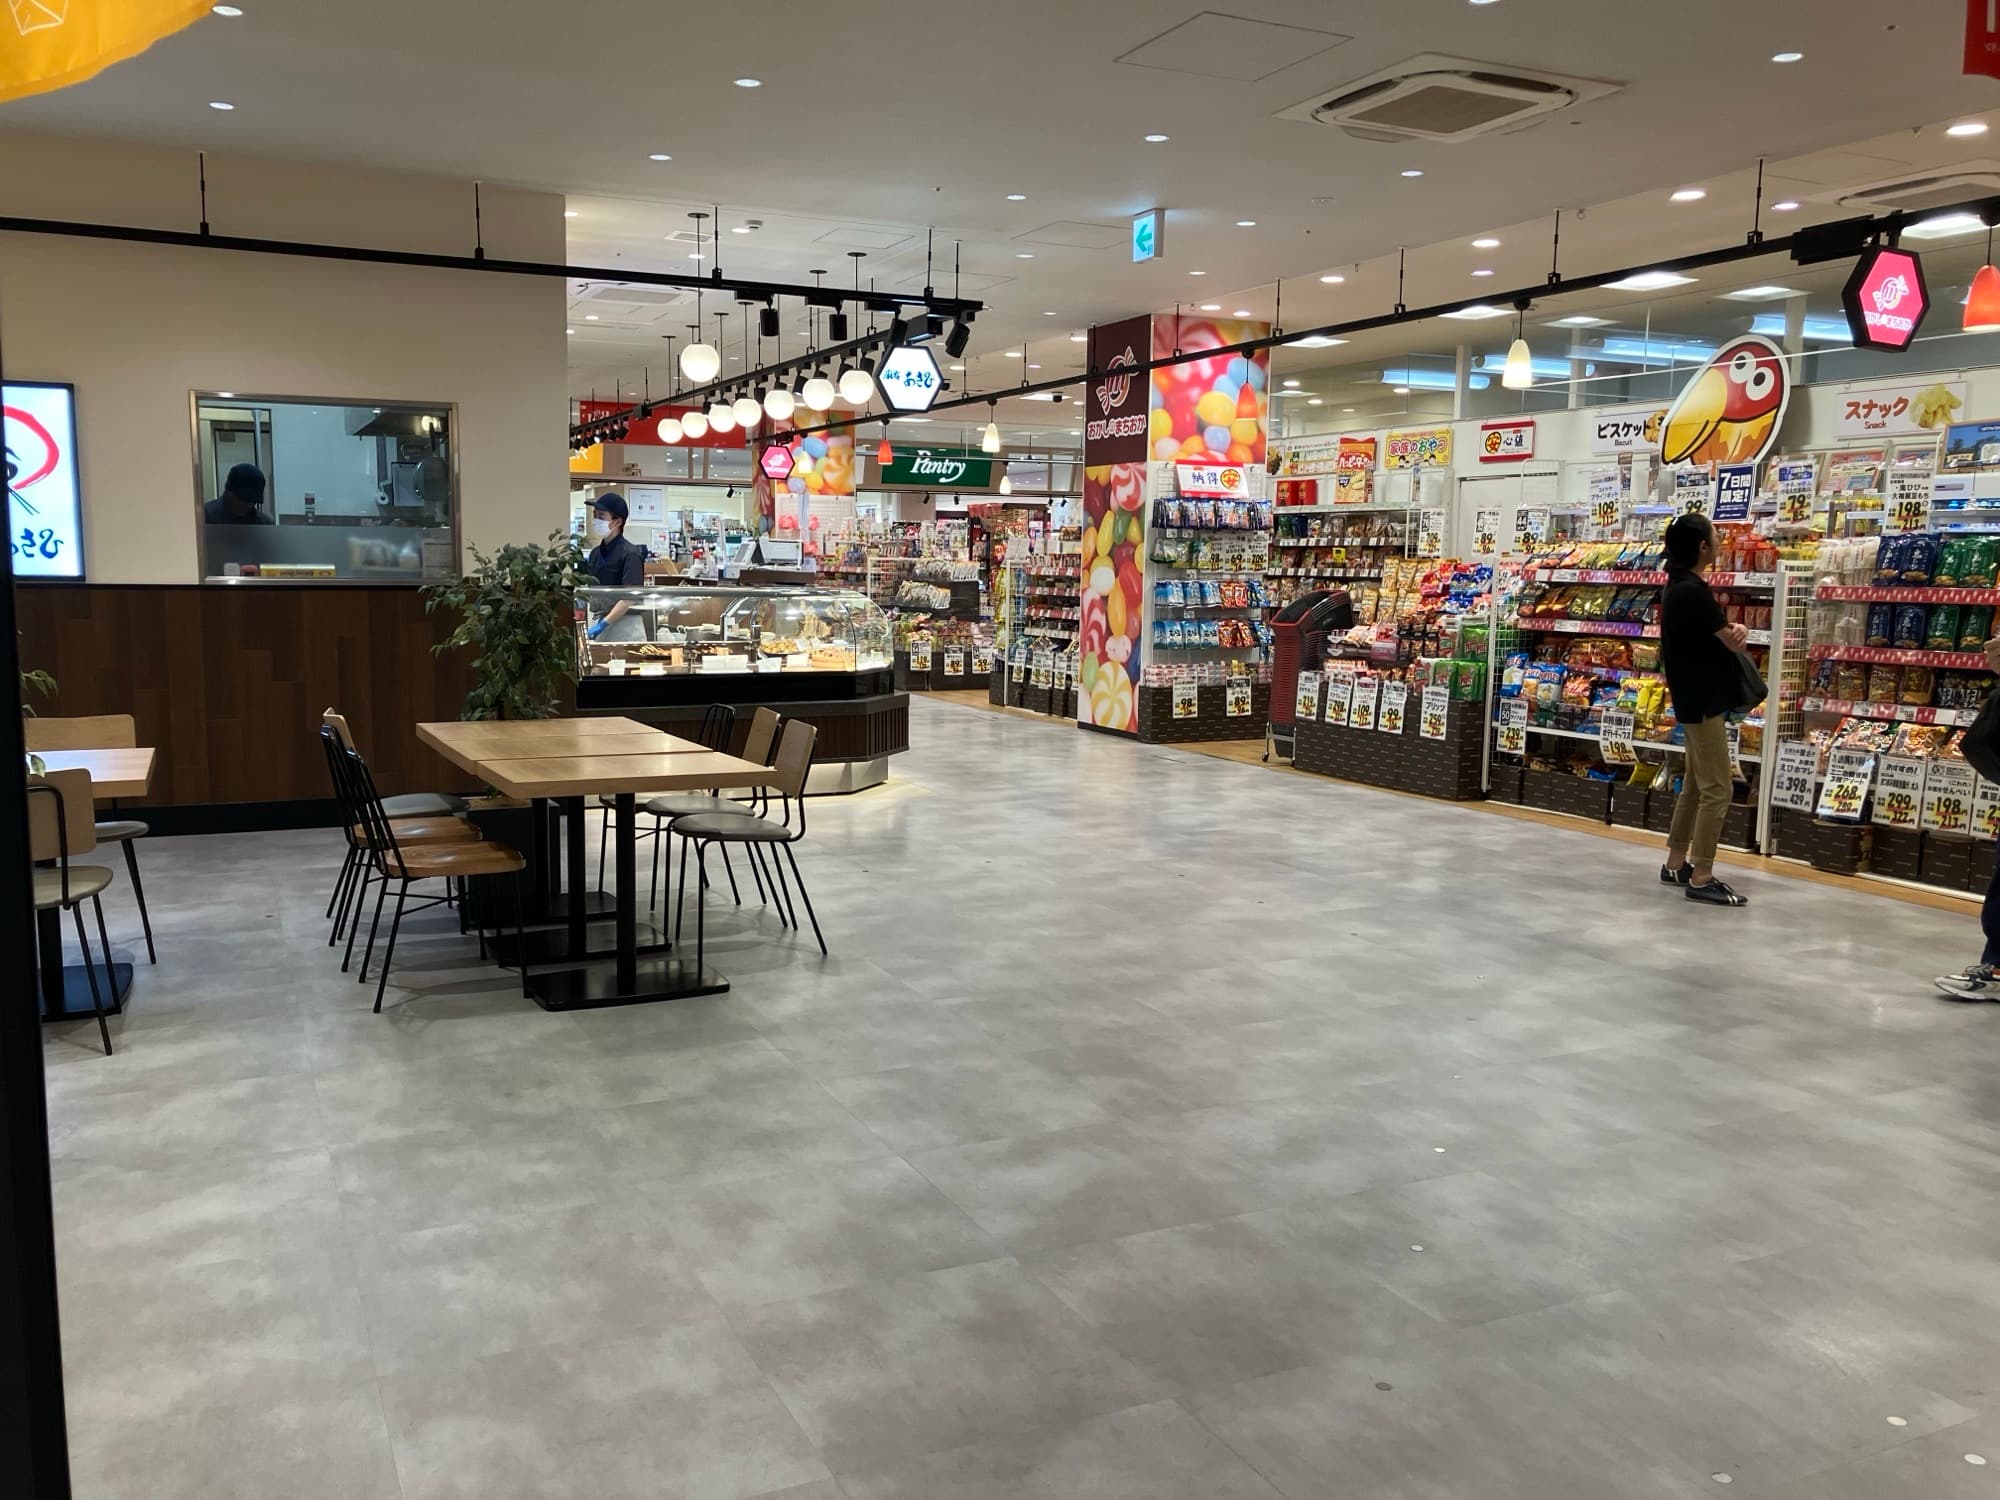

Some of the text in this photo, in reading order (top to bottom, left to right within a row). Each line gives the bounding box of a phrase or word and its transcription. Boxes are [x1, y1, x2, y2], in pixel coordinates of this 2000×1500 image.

[1844, 396, 1909, 420] スナック
[1597, 421, 1650, 438] ビスケット
[1863, 420, 1887, 430] Snack
[1389, 437, 1448, 456] 家族のおやつ
[909, 449, 966, 483] Pantry
[1720, 472, 1752, 490] 7日間
[12, 528, 64, 559] さひ
